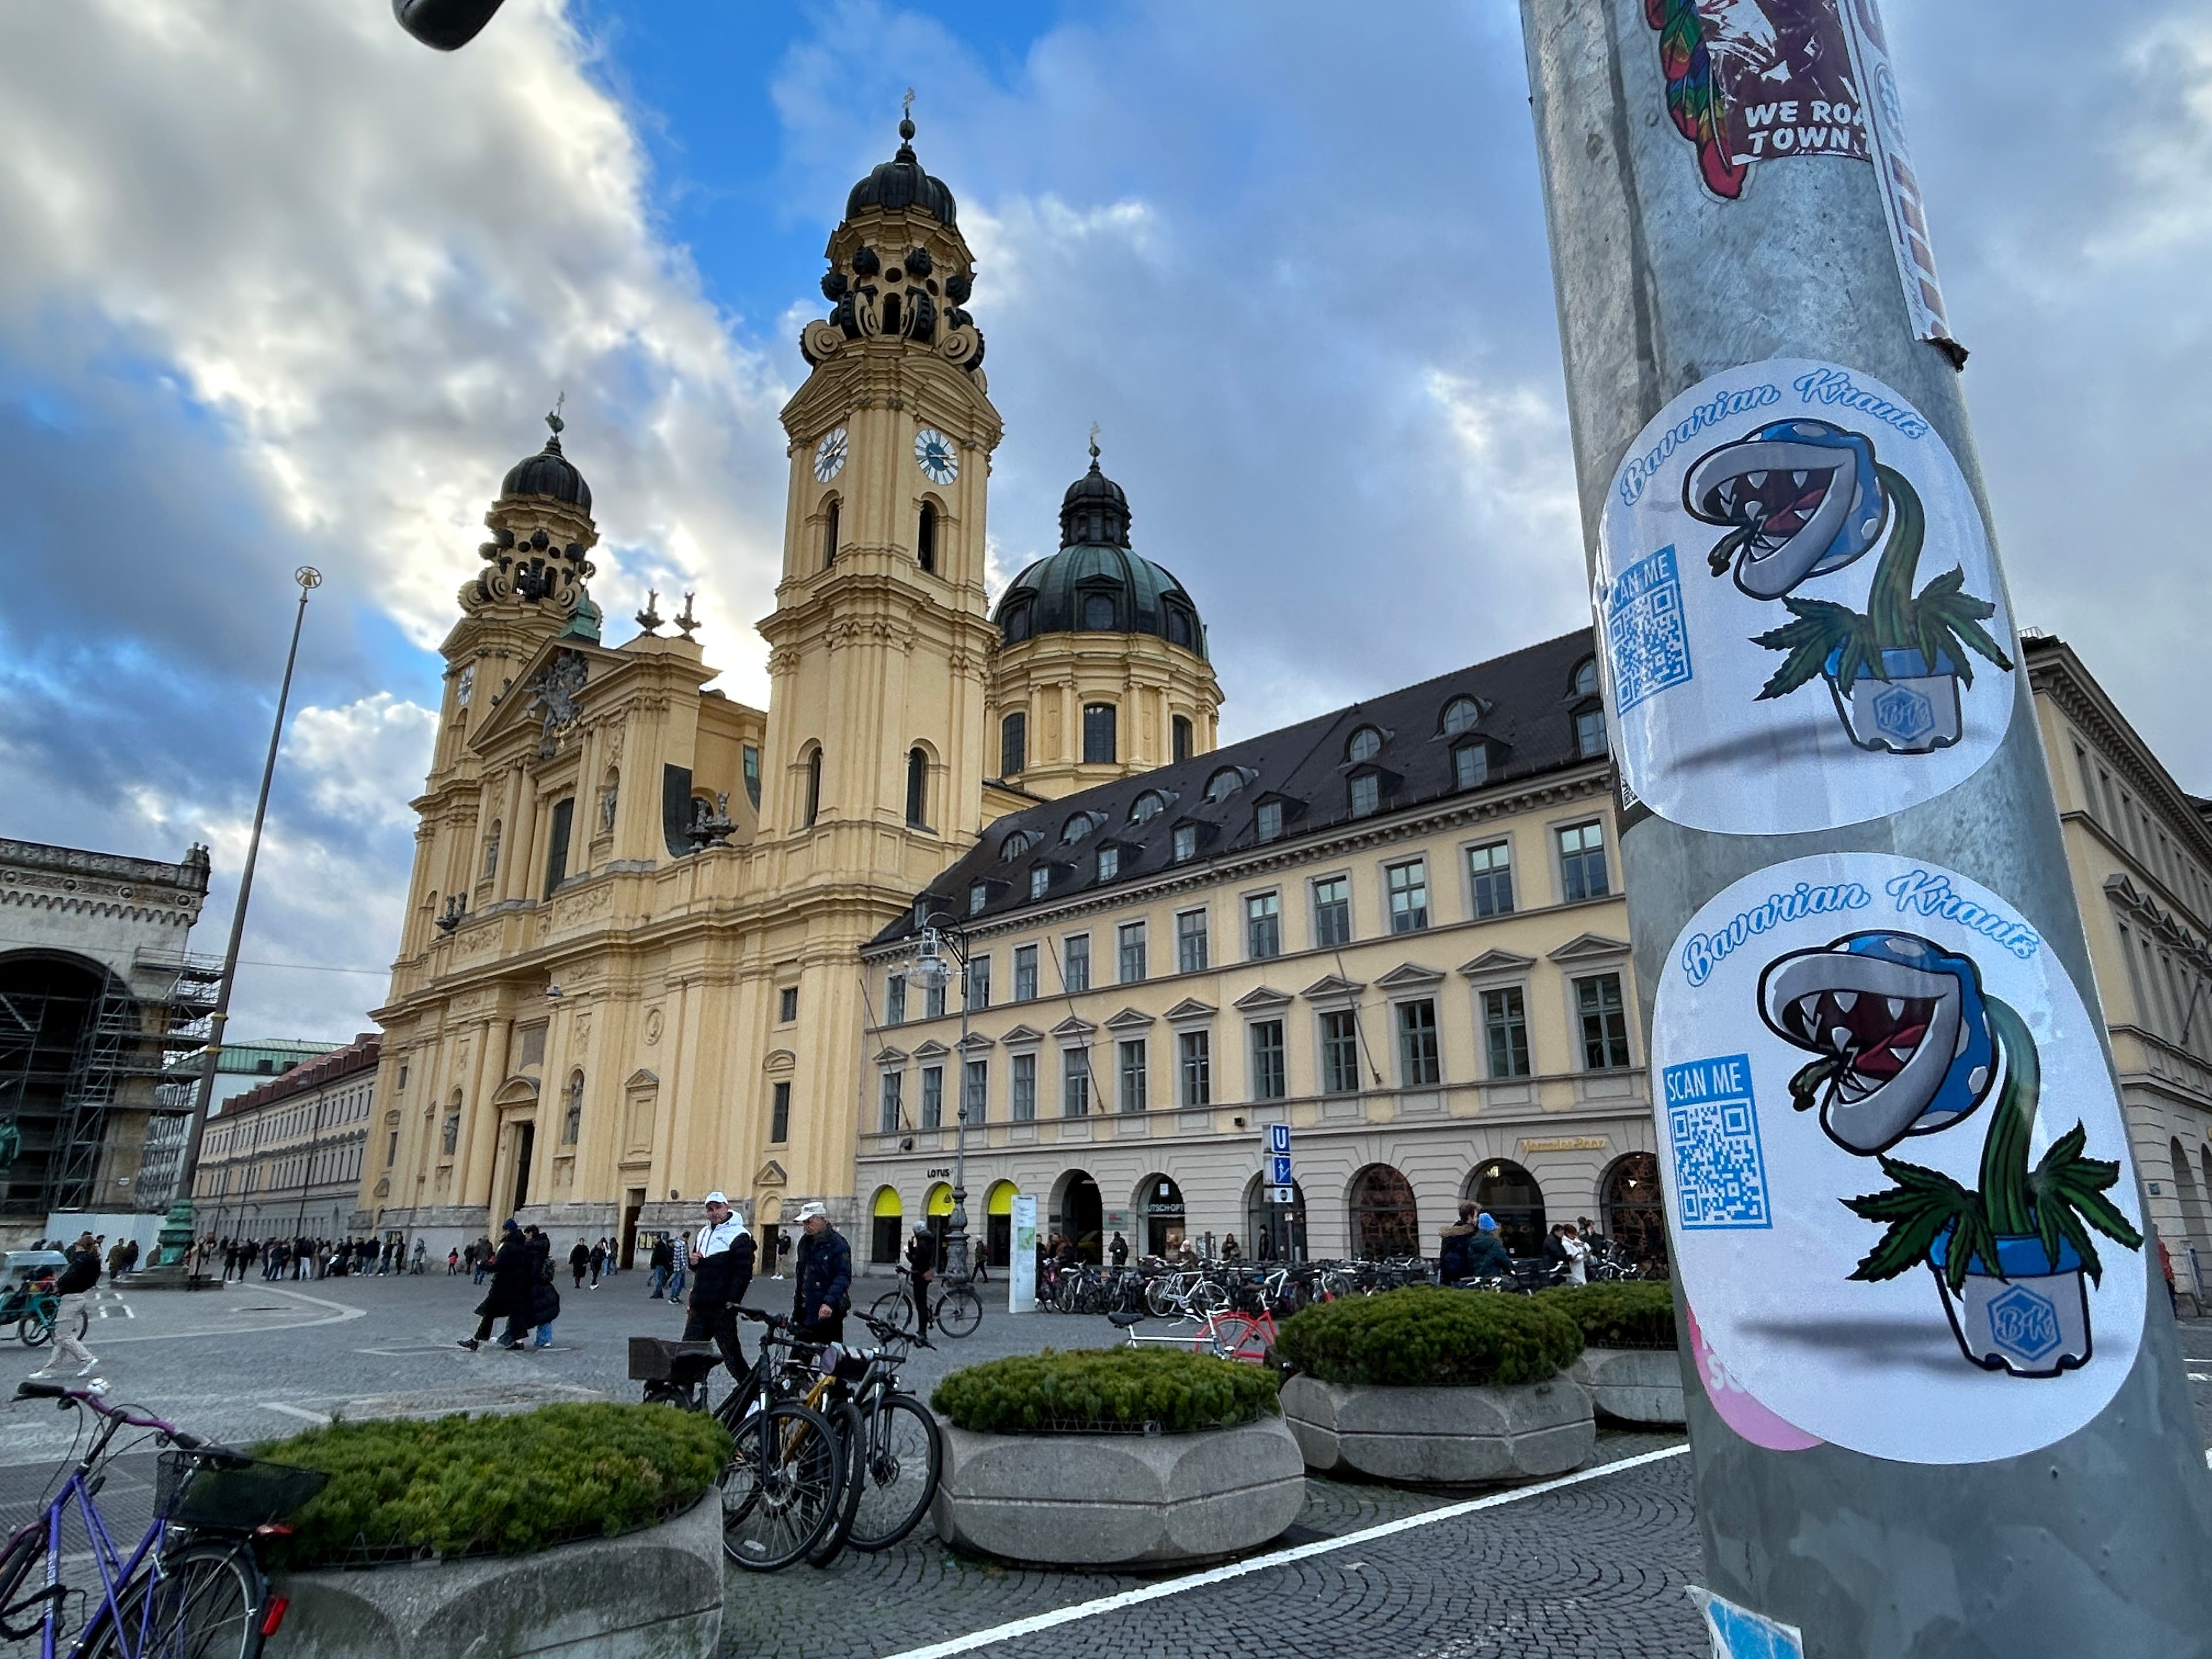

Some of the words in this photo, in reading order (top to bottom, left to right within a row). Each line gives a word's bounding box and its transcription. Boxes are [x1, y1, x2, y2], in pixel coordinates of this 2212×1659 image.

[1745, 100, 1798, 128] WE
[1748, 126, 1850, 154] TOWN
[1620, 384, 1781, 506] Bavarian
[1793, 368, 1928, 440] Krauts
[1611, 569, 1639, 607] CAN
[1643, 552, 1670, 588] ME
[1681, 882, 1870, 987] Bavarian
[1885, 870, 2040, 959] Krauts
[1666, 1067, 1706, 1102] SCAN
[1713, 1062, 1743, 1094] ME
[1275, 1128, 1286, 1149] U
[927, 1169, 950, 1178] LOTUS
